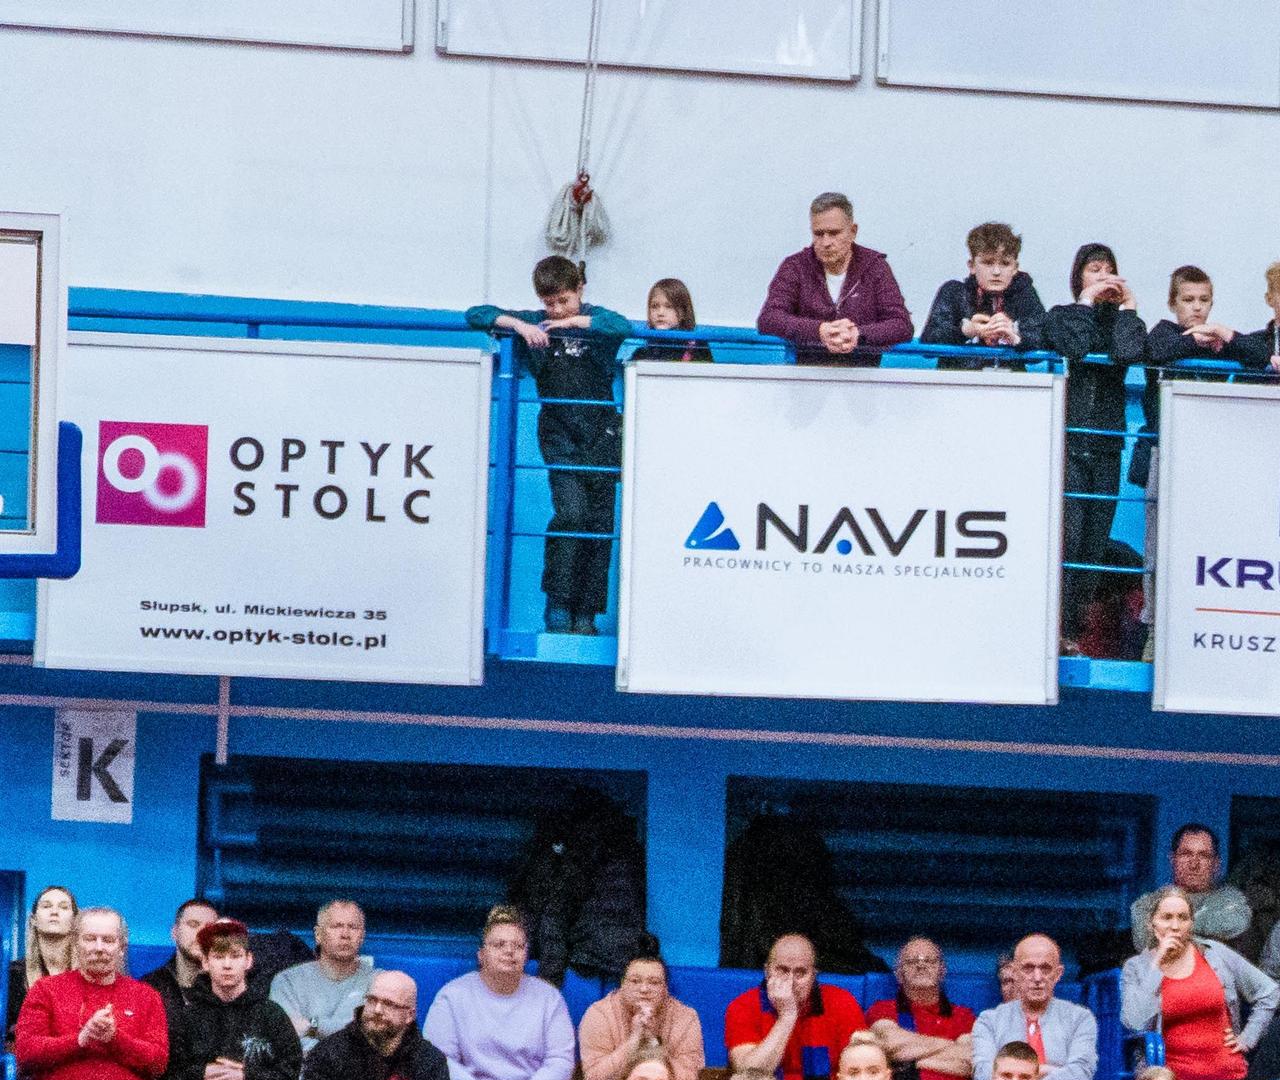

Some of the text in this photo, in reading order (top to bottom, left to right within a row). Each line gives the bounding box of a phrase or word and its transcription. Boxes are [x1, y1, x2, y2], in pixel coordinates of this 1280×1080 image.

[230, 435, 436, 480] OPTYK
[231, 481, 431, 525] STOLC
[756, 502, 1009, 560] NAVIS
[683, 555, 1006, 579] PRACOWNICY TO NASZA SPECJALNOŚĆ
[139, 600, 388, 621] Słupsk, ul. Mickiewicza 35
[139, 626, 388, 650] www.optyk-stolc.pl
[77, 737, 130, 803] K
